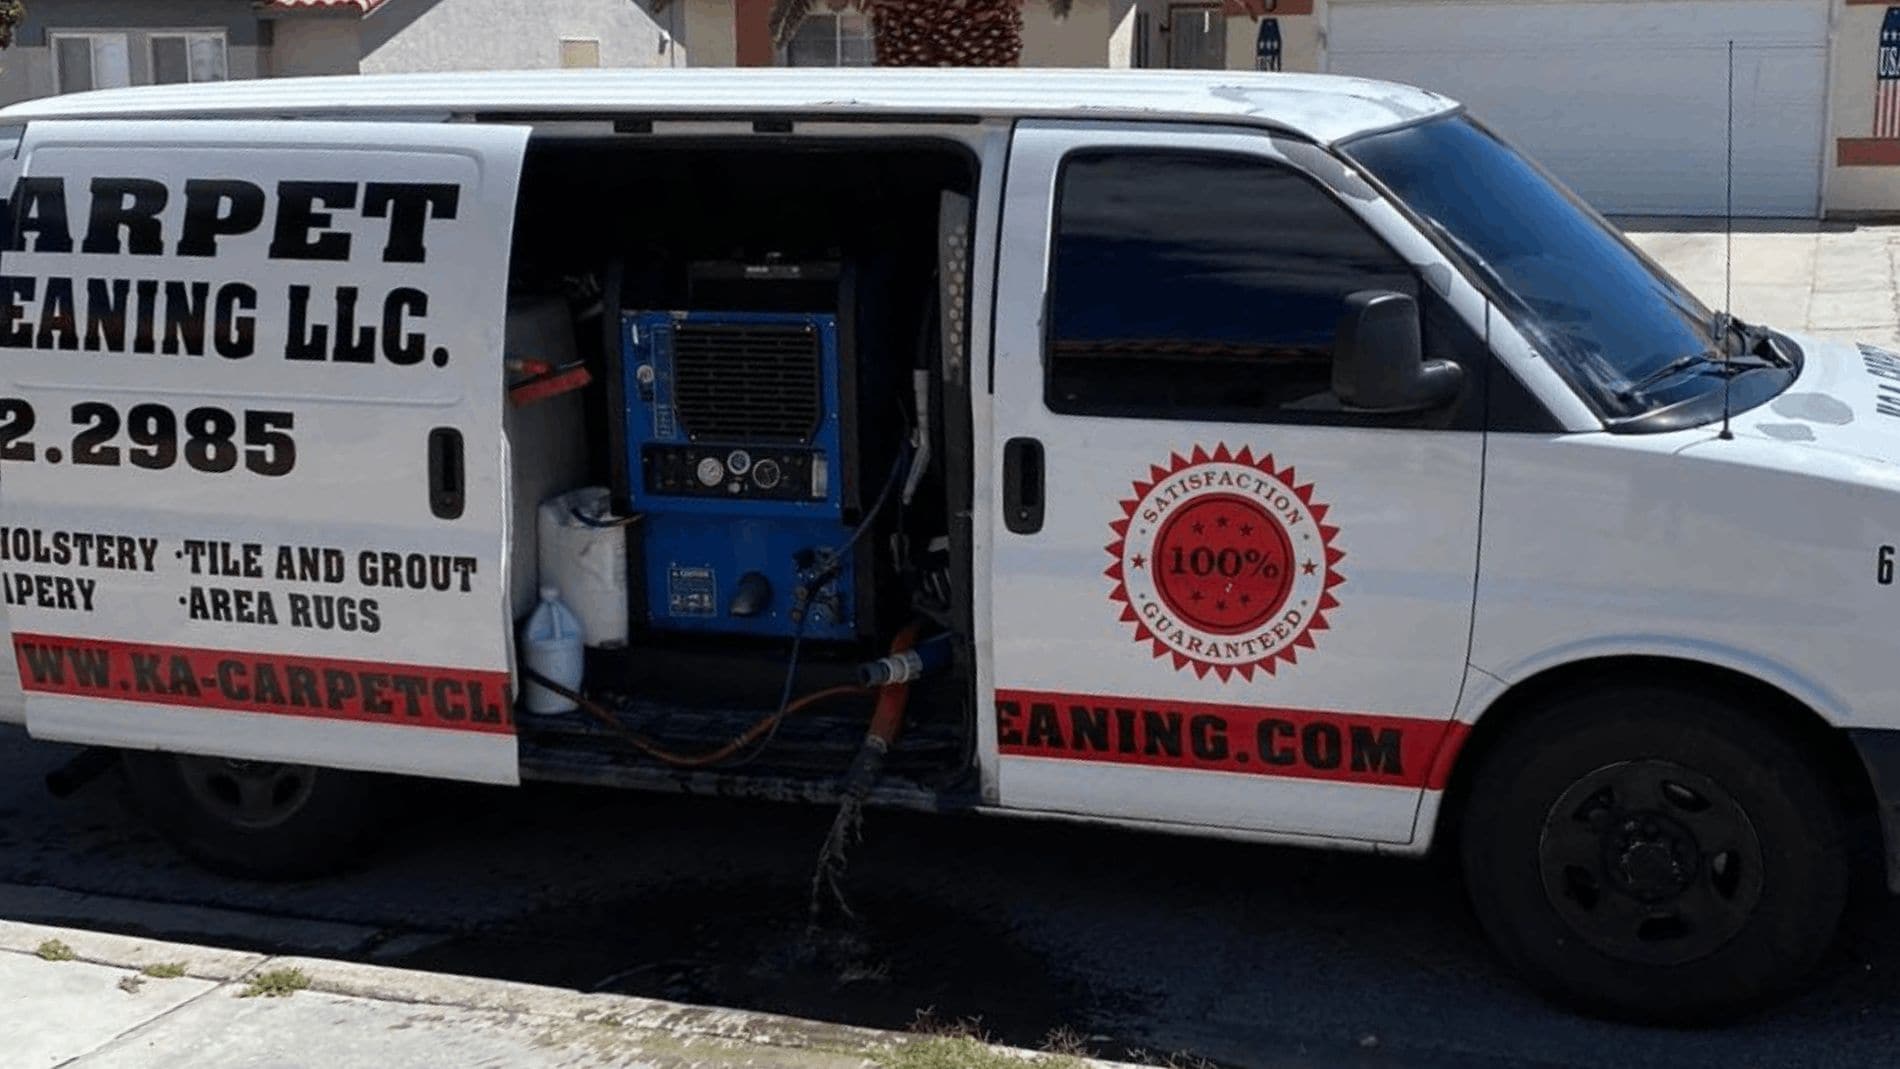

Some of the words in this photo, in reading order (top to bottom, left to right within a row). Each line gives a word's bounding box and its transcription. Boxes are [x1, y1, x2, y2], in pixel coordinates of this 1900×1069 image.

[1880, 46, 1900, 76] US
[1, 176, 460, 263] ARPET
[0, 275, 257, 360] EANING
[284, 284, 449, 368] LLC.
[0, 398, 296, 477] 2.2985
[1143, 470, 1304, 526] SATISFACTION
[275, 545, 345, 584] AND
[357, 551, 477, 592] GROUT
[1168, 546, 1280, 579] 100%
[1876, 545, 1895, 585] 6
[290, 594, 381, 633] RUGS
[1142, 601, 1302, 658] GUARANTEED
[995, 701, 1406, 776] EANING.COM
